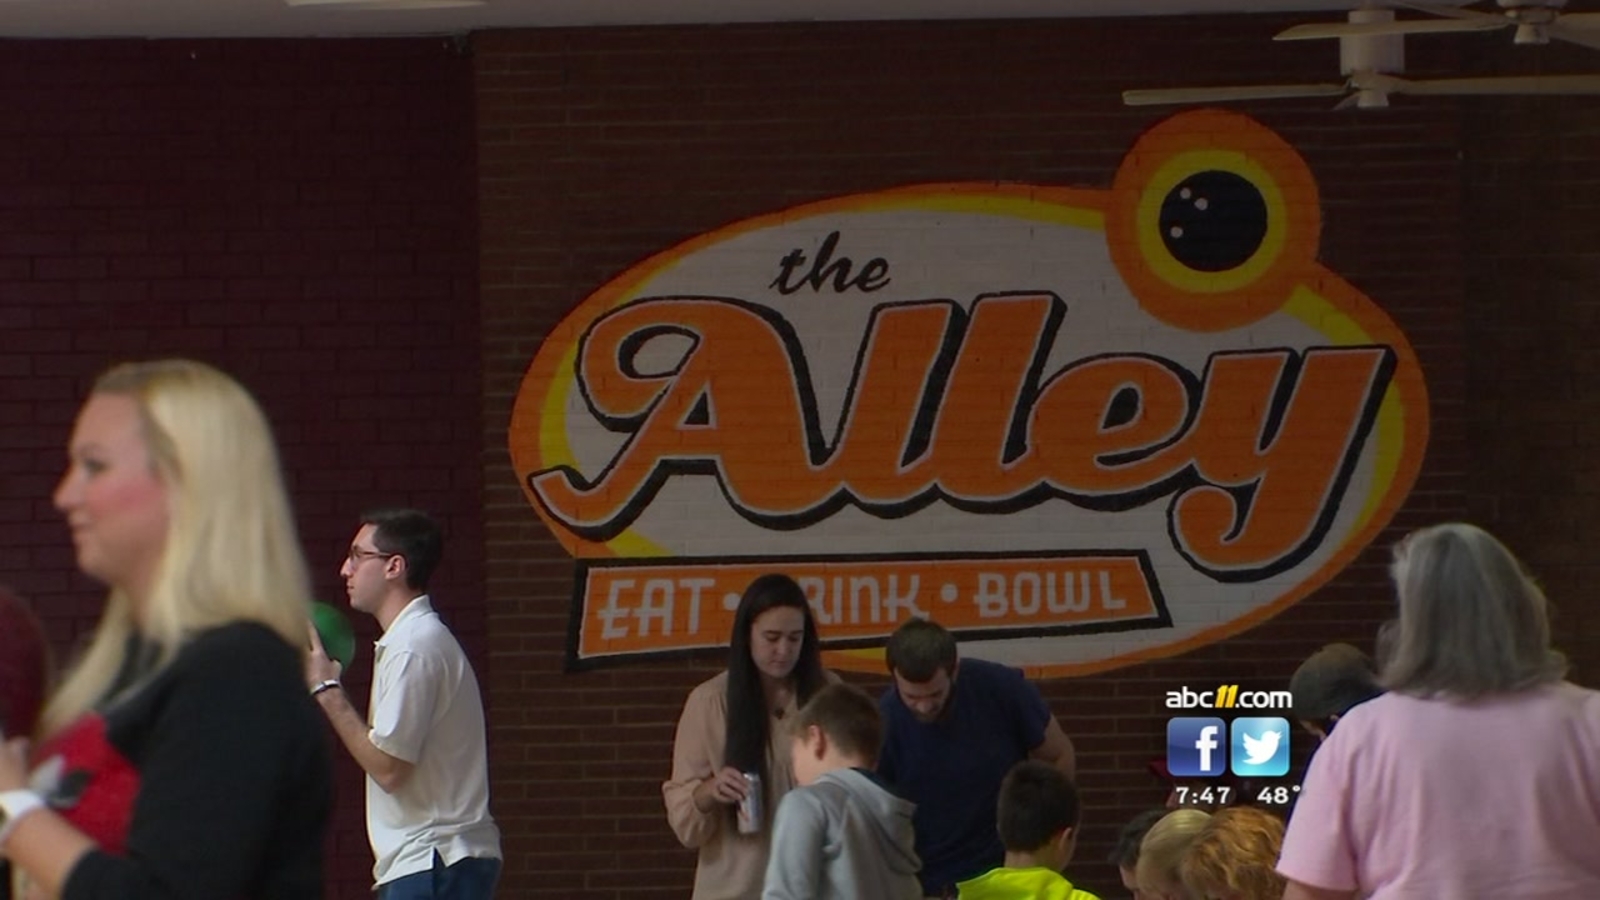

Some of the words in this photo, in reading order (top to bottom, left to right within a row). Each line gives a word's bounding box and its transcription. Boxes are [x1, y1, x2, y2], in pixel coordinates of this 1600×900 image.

[769, 230, 891, 295] the
[528, 291, 1397, 582] Alley
[597, 578, 715, 640] EAT
[797, 574, 931, 624] RINK
[973, 571, 1127, 618] BOWL
